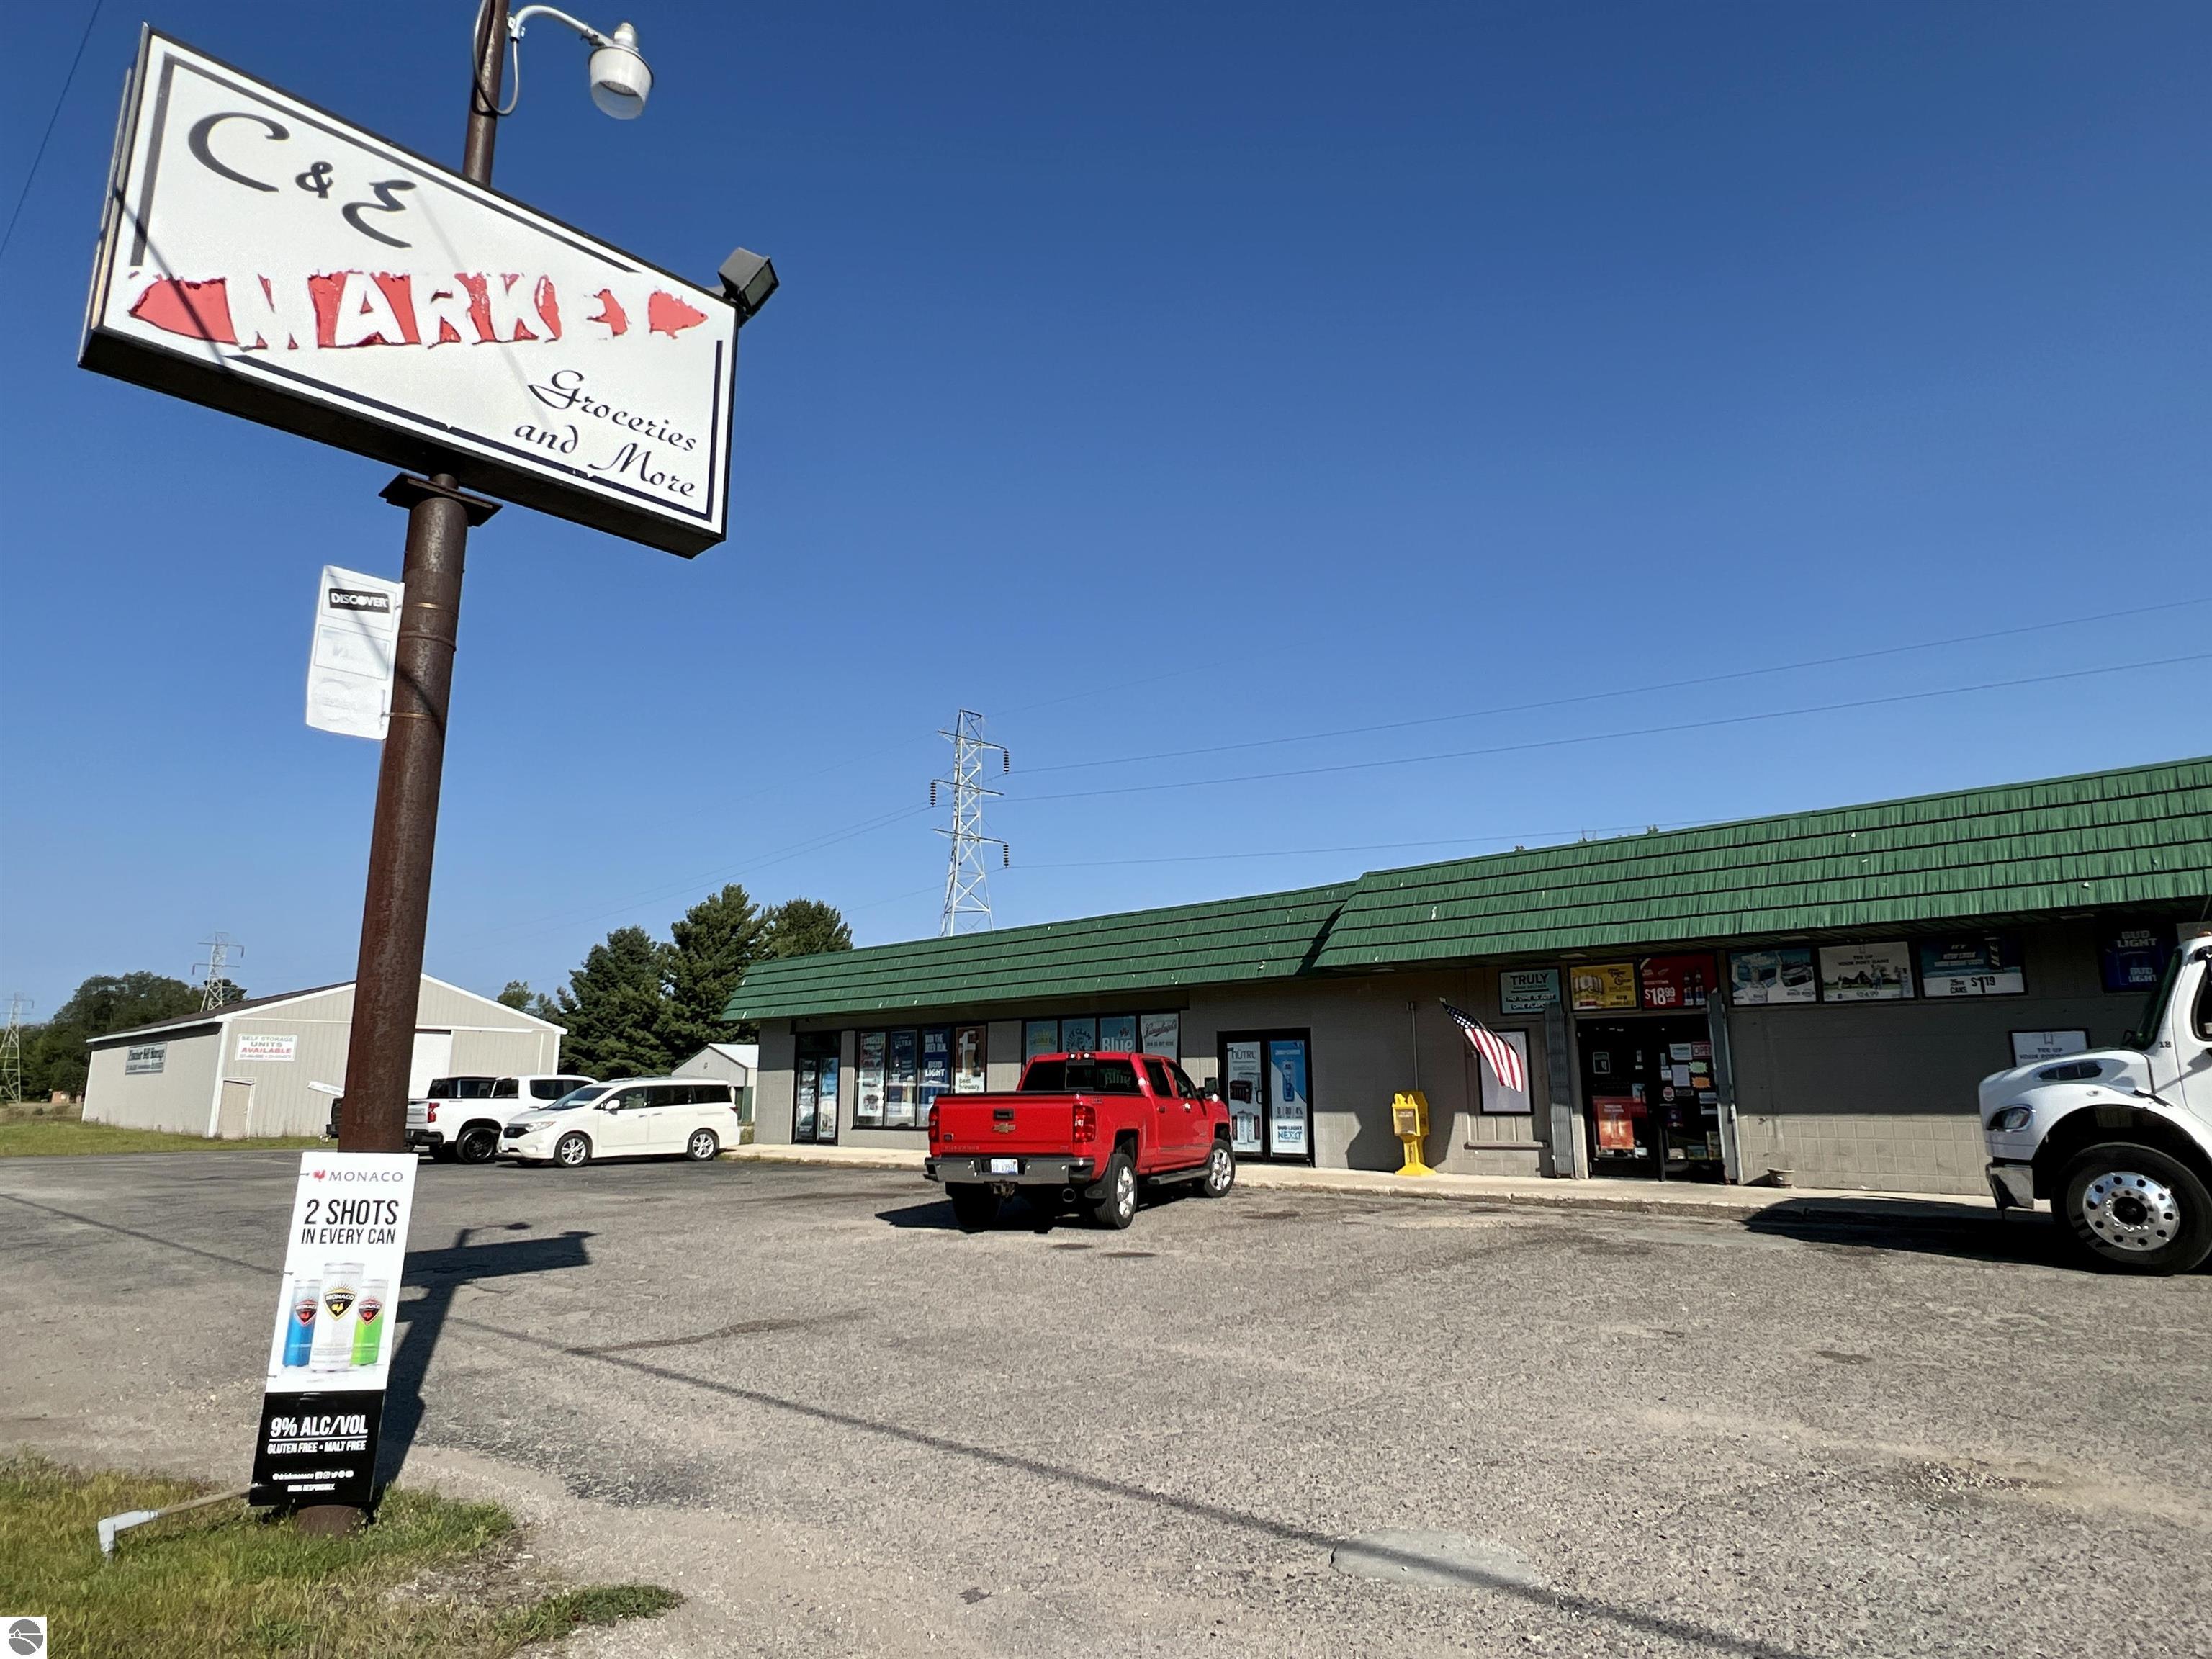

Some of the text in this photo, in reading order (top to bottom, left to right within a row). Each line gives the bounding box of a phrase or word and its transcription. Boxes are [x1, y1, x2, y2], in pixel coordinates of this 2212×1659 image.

[188, 111, 417, 248] C & E
[527, 369, 696, 451] Groceries
[514, 424, 696, 498] and More
[331, 593, 387, 608] DISCOVER
[2116, 938, 2157, 948] LIGHT
[1510, 974, 1548, 986] TRULY
[1102, 1037, 1133, 1052] Blue
[925, 1068, 945, 1077] LIGHT
[328, 1171, 404, 1182] MONACO
[304, 1199, 400, 1225] 2 SHOTS
[301, 1228, 397, 1244] IN EVERY CAN
[270, 1414, 369, 1437] 9% ALC/VOL
[267, 1440, 367, 1455] GLUTEN FREE MALT FREE
